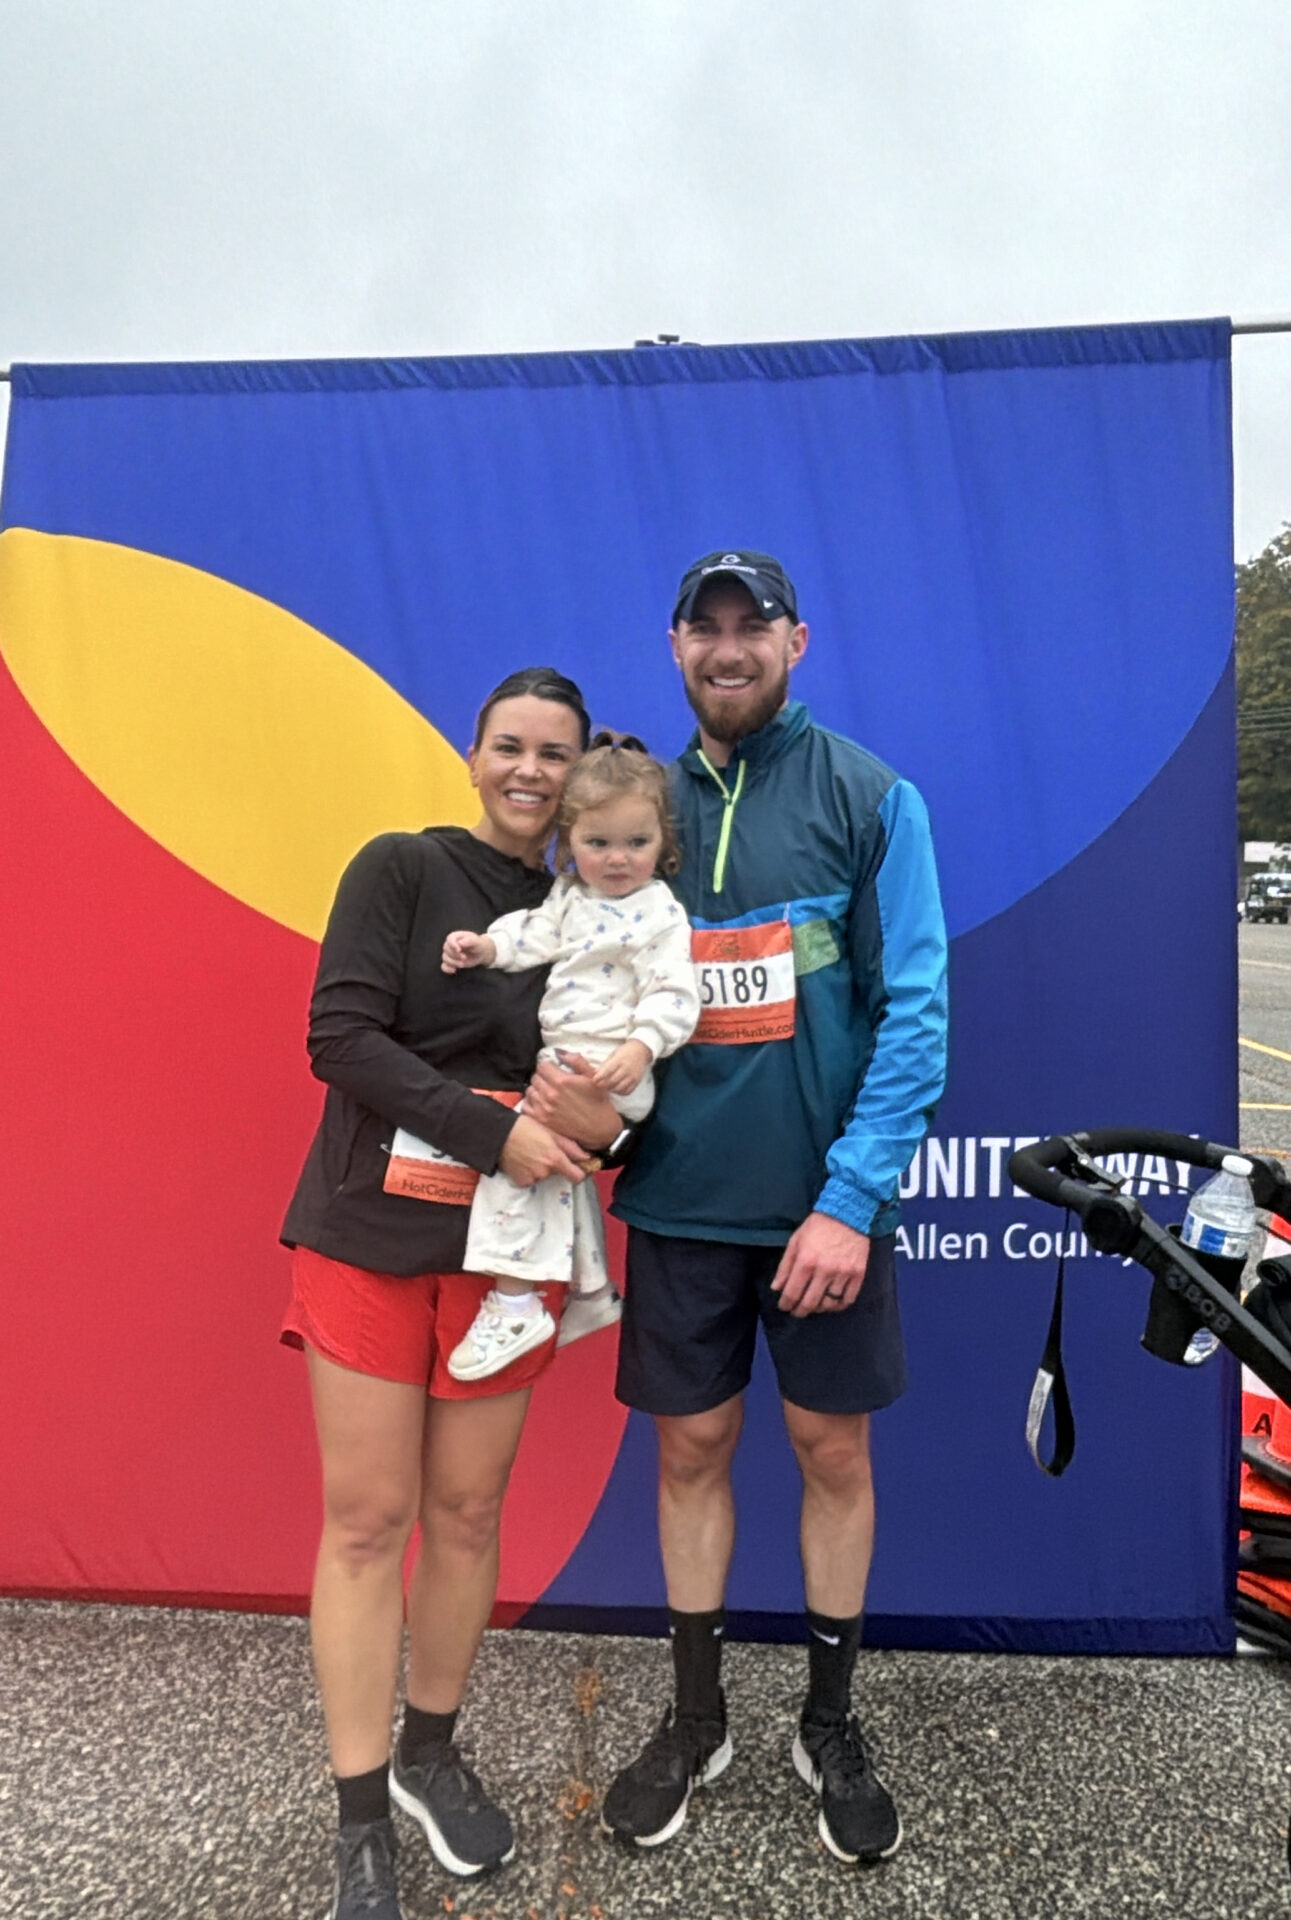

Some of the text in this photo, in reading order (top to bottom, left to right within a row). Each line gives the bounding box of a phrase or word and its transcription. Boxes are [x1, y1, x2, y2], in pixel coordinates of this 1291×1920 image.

[701, 965, 767, 1005] 5189
[898, 1136, 1056, 1199] UNIT
[894, 1223, 988, 1261] Allen
